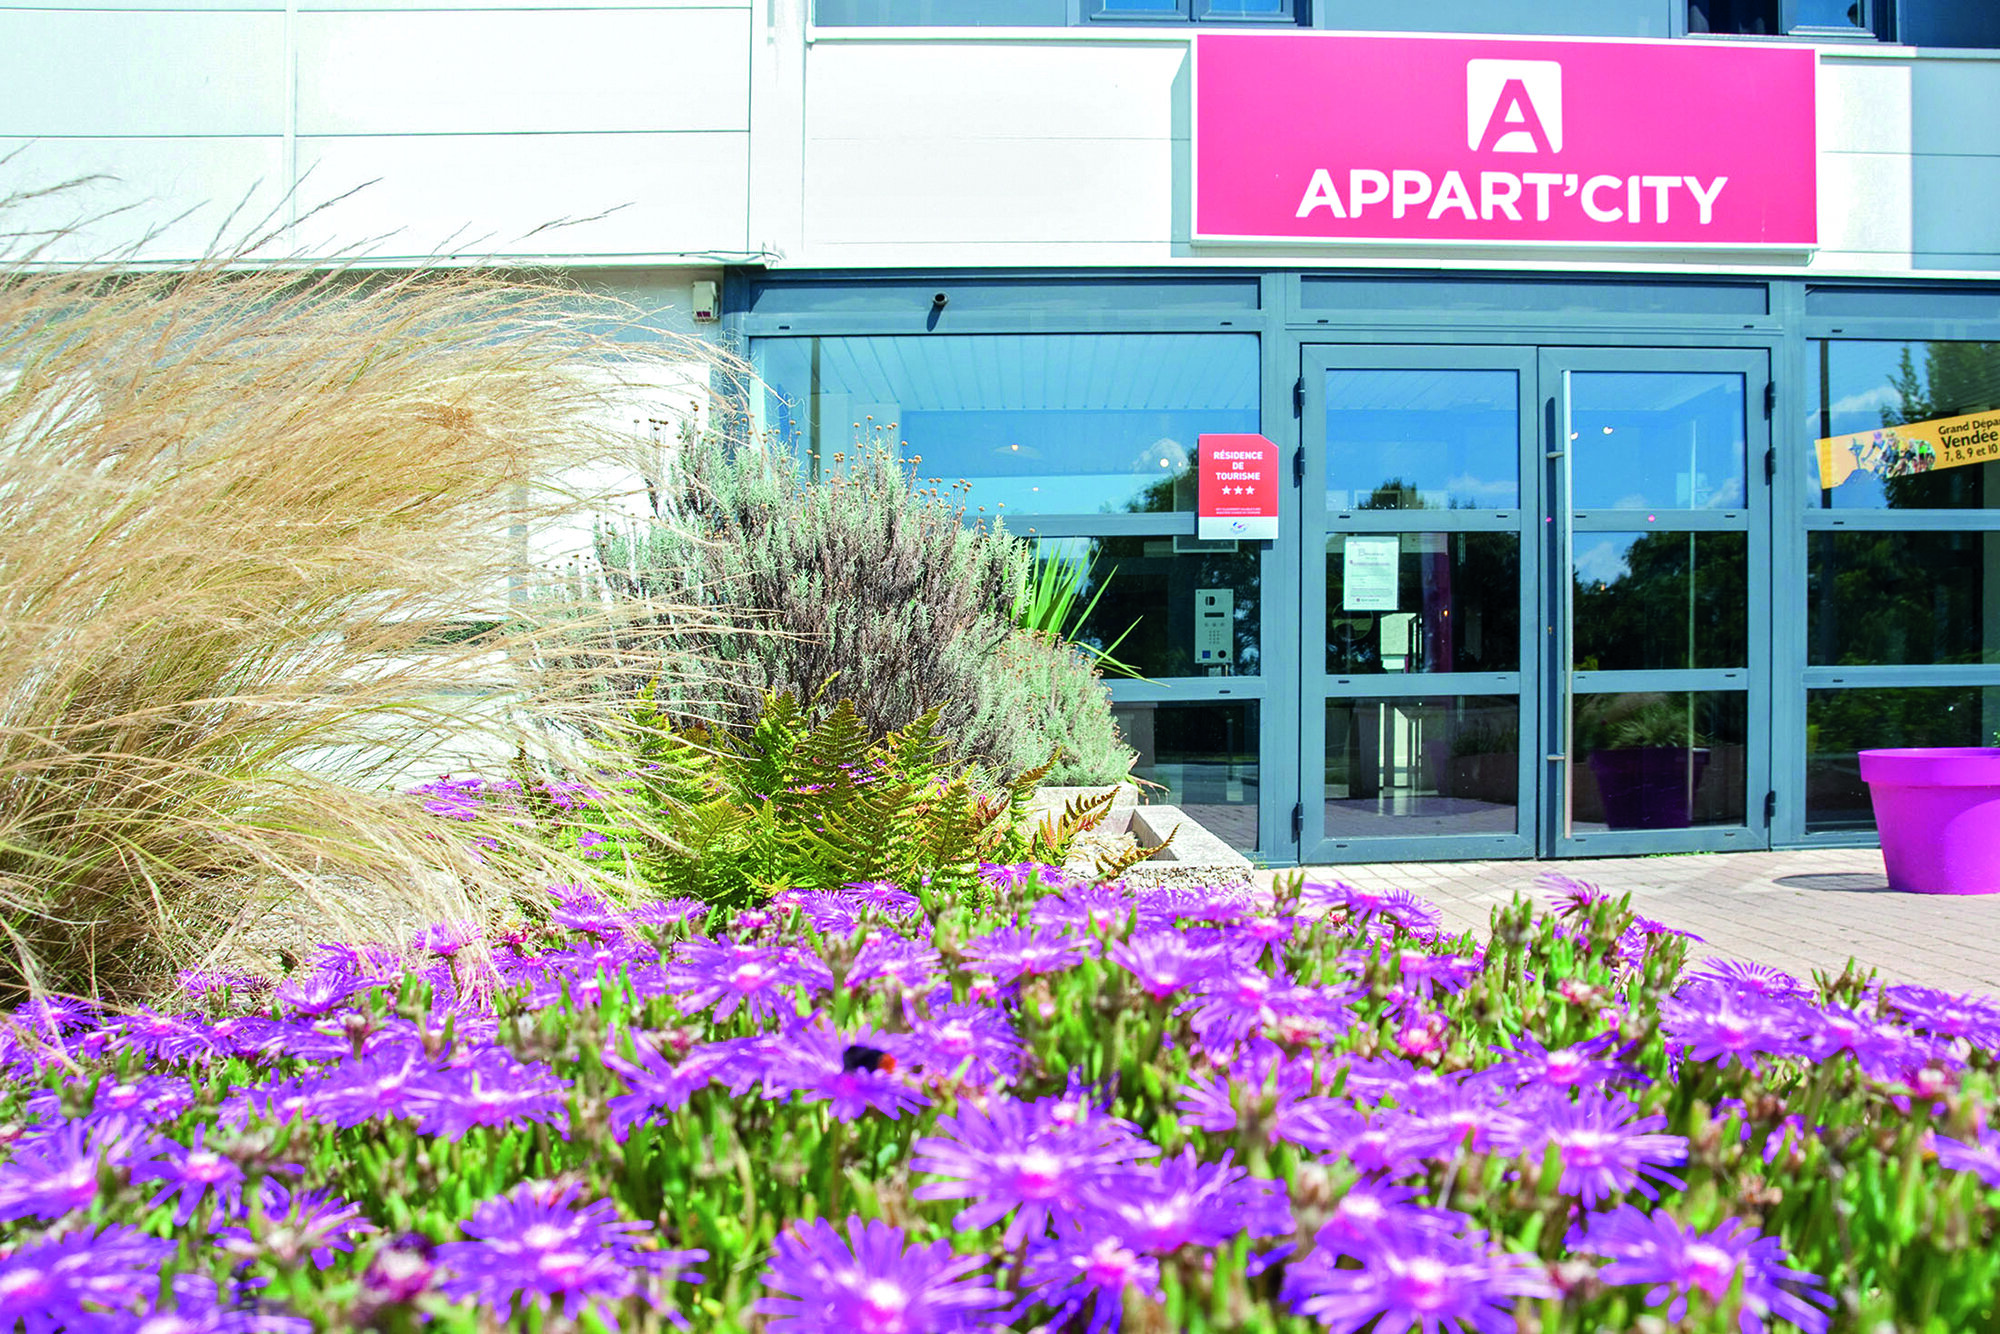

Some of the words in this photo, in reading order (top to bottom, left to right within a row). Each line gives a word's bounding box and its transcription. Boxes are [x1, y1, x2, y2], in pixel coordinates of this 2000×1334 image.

[1476, 78, 1555, 152] A
[1295, 168, 1729, 225] APPART'CITY
[1938, 422, 1969, 434] Grand
[1972, 419, 2000, 430] Dépa
[1941, 429, 1998, 448] Vendée
[1213, 449, 1263, 460] RÉSIDENCE
[1944, 451, 1954, 462] 7,
[1955, 449, 1966, 460] 8,
[1966, 448, 1973, 458] 9
[1976, 447, 1986, 456] et
[1987, 443, 1998, 455] 10
[1232, 461, 1244, 470] DE
[1215, 471, 1261, 481] TOURISME
